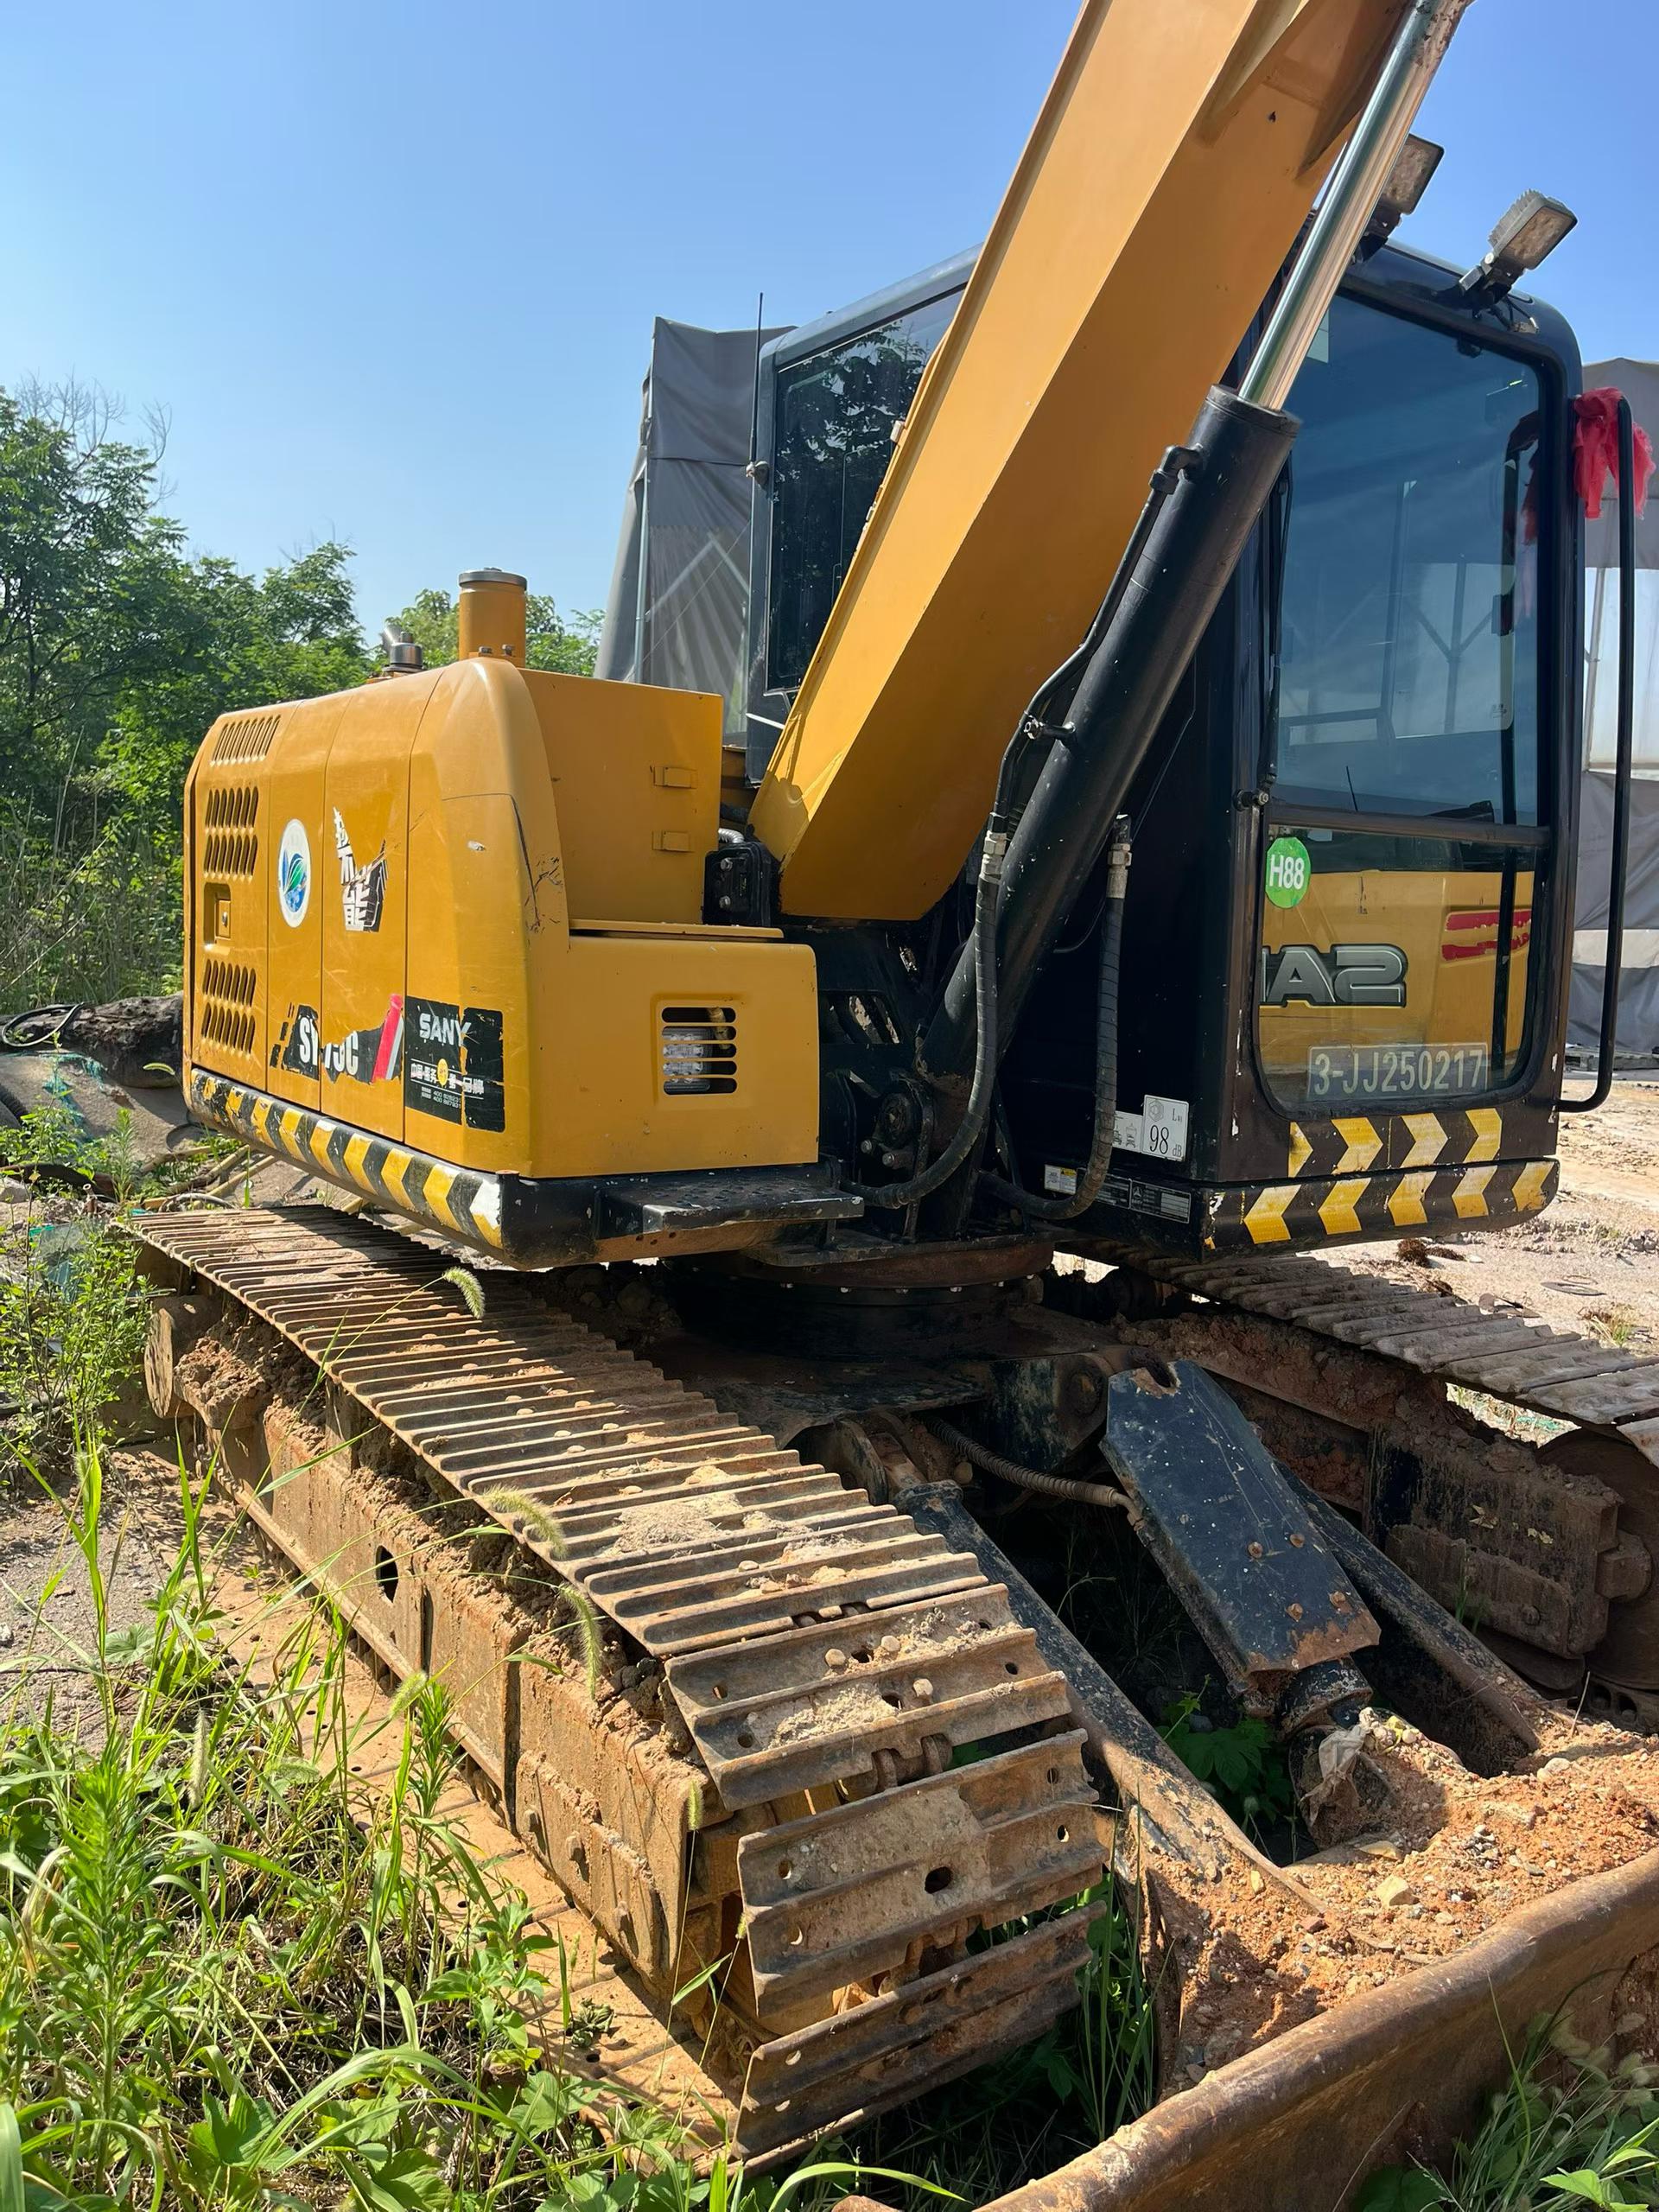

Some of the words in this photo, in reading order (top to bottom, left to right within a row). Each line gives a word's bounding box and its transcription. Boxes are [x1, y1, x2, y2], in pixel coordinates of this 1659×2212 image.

[1268, 854, 1305, 890] H88
[419, 1013, 472, 1046] SANY
[1313, 1048, 1484, 1096] 3-JJ250217
[1149, 1124, 1169, 1155] 98
[1172, 1143, 1183, 1158] dB
